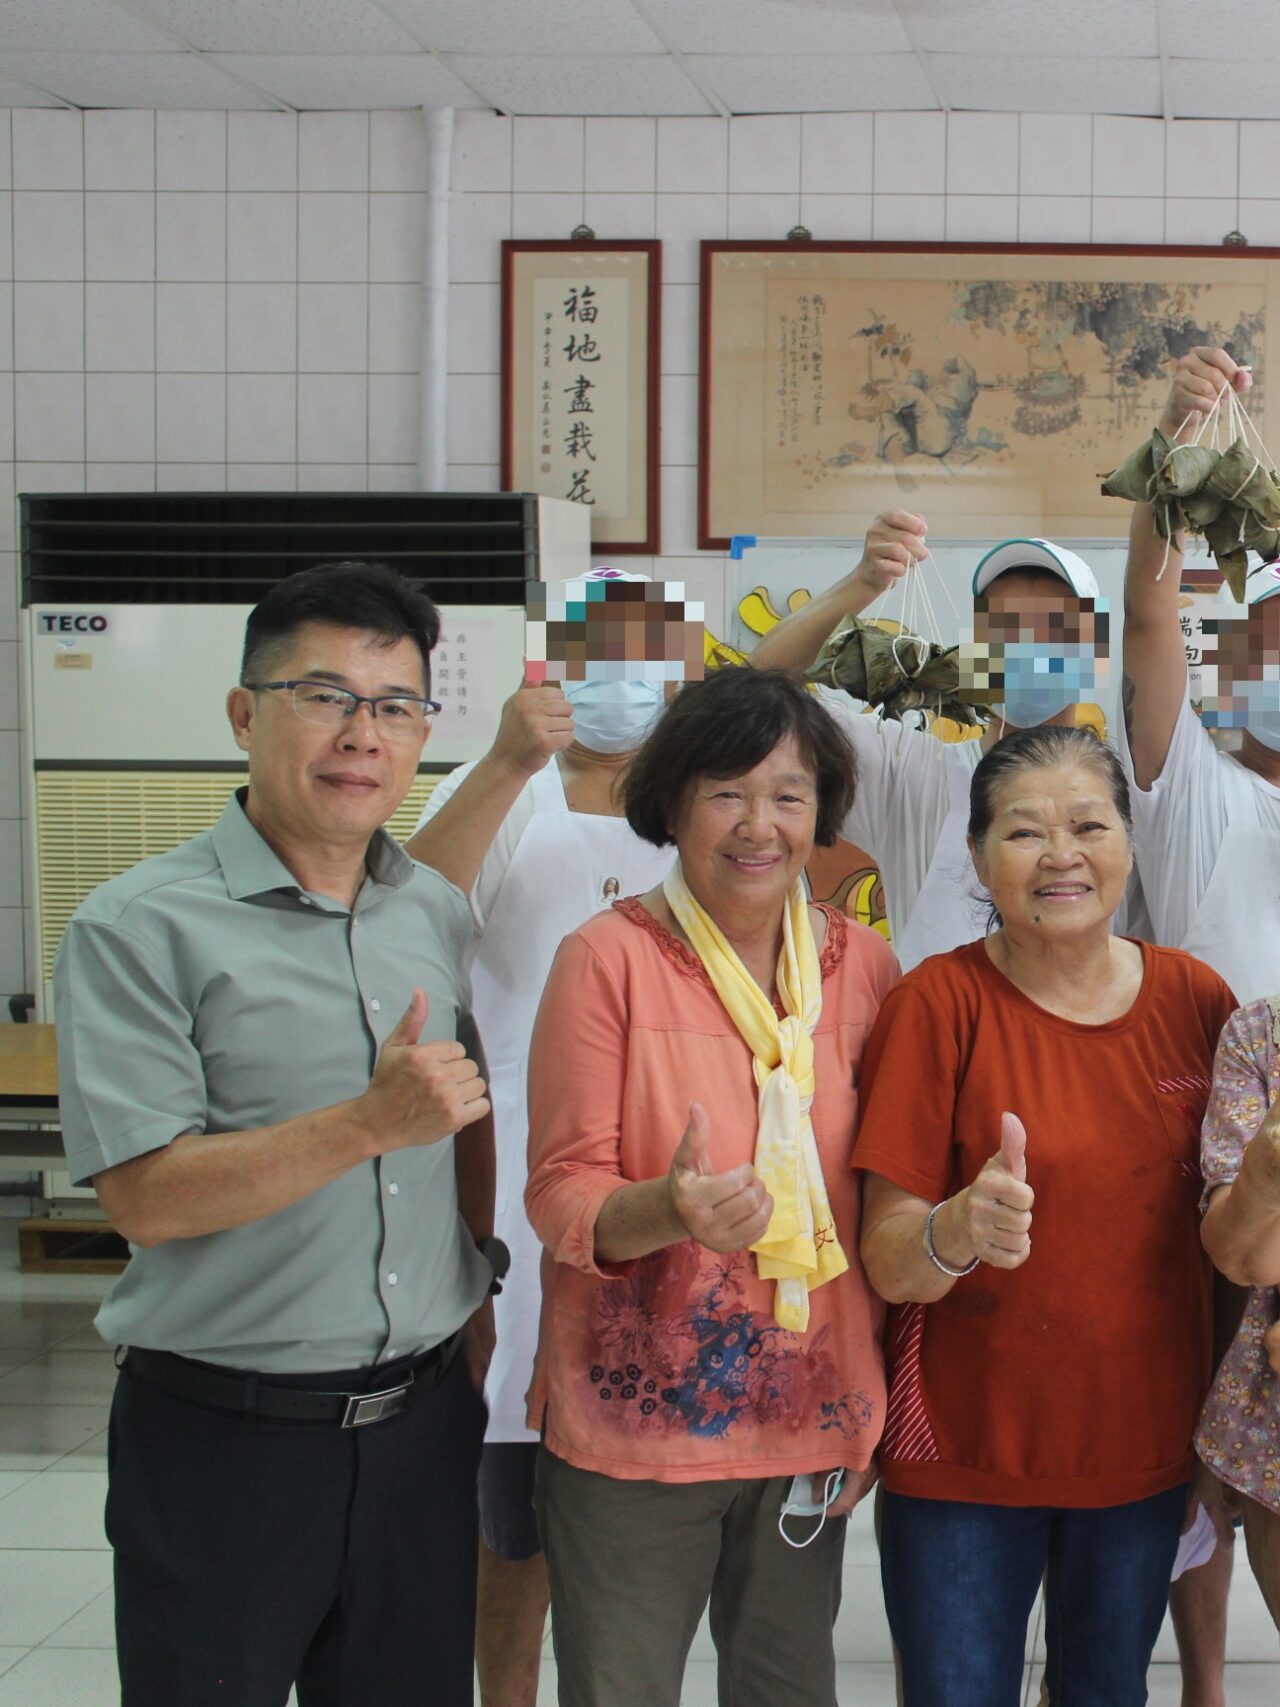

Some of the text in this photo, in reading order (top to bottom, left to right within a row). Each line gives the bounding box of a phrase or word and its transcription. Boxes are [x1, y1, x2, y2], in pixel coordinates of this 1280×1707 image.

[561, 284, 601, 506] 福地盡栽花
[42, 615, 107, 632] TECO
